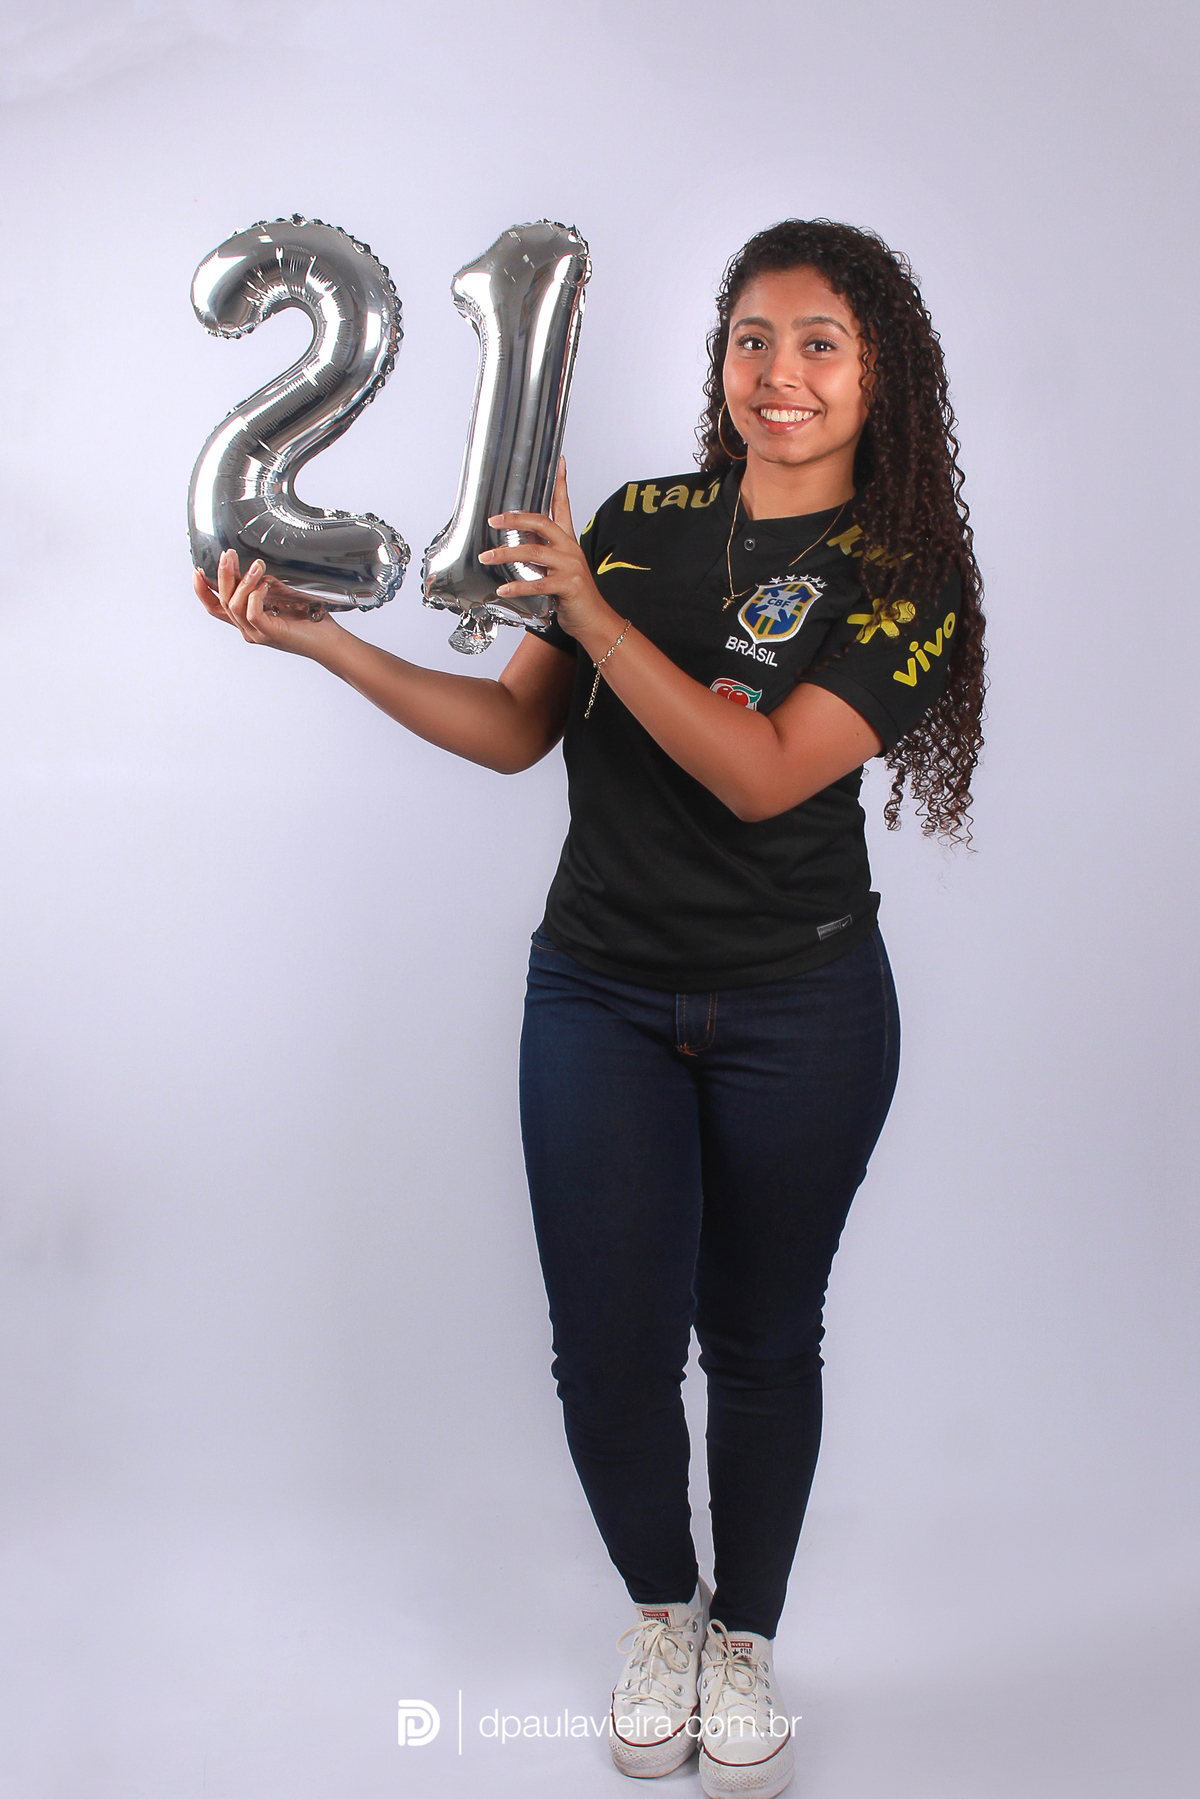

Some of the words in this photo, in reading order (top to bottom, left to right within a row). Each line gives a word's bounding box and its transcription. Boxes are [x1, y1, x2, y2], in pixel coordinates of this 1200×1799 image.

[623, 478, 721, 514] Itaú
[767, 598, 792, 608] CBF
[725, 635, 778, 668] BRASIL
[893, 612, 956, 687] vivo
